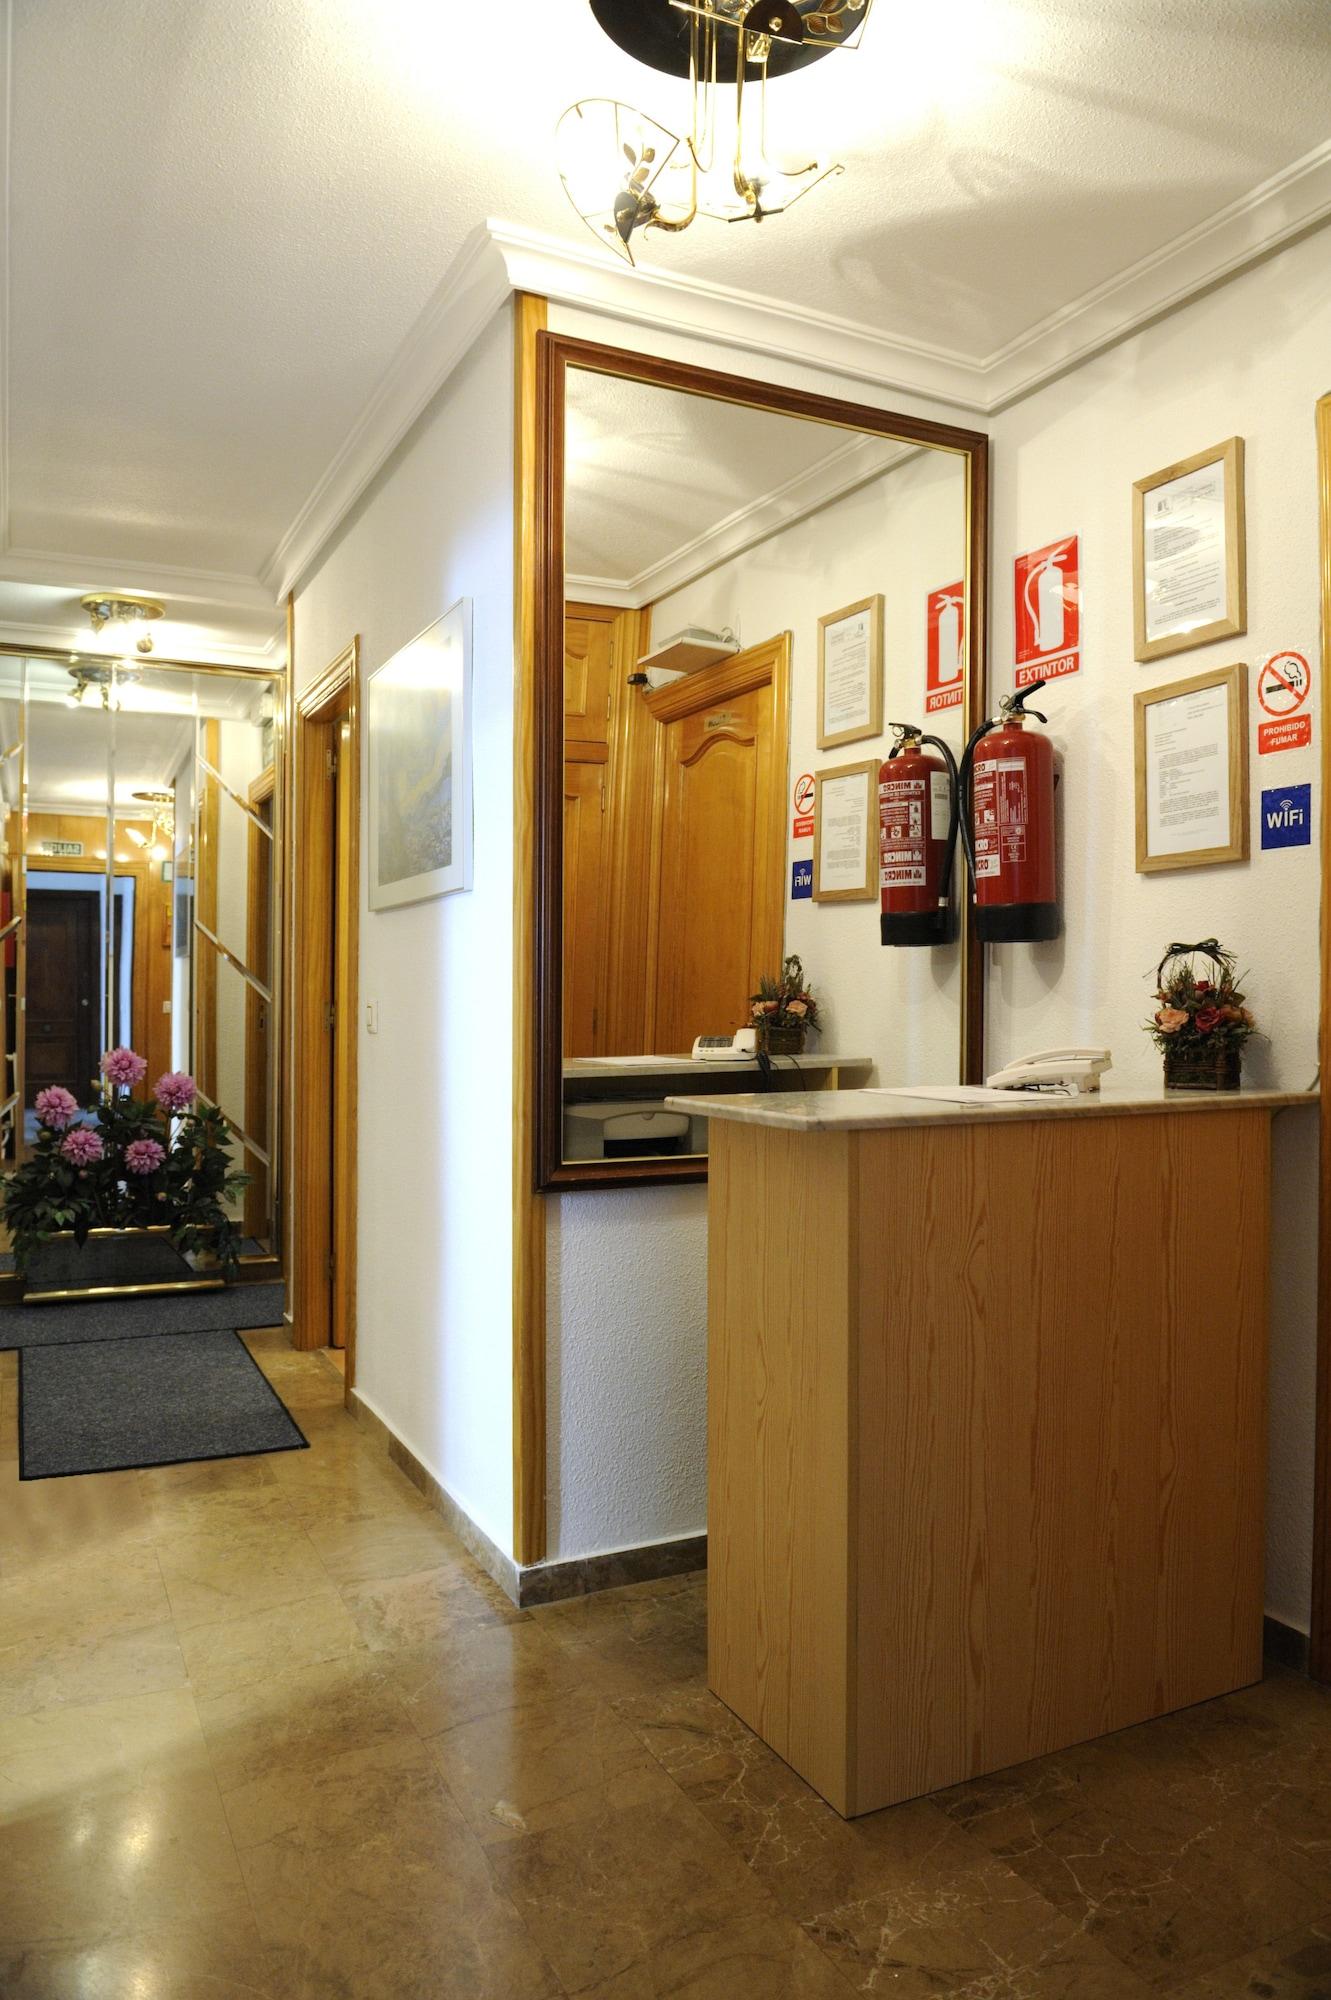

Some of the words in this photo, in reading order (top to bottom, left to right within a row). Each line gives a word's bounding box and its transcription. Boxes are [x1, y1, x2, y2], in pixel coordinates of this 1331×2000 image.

[1019, 656, 1075, 685] EXTINTOR
[1263, 721, 1306, 736] PROHIBIDO
[1271, 733, 1298, 746] FUMAR
[1266, 807, 1304, 829] WiFi
